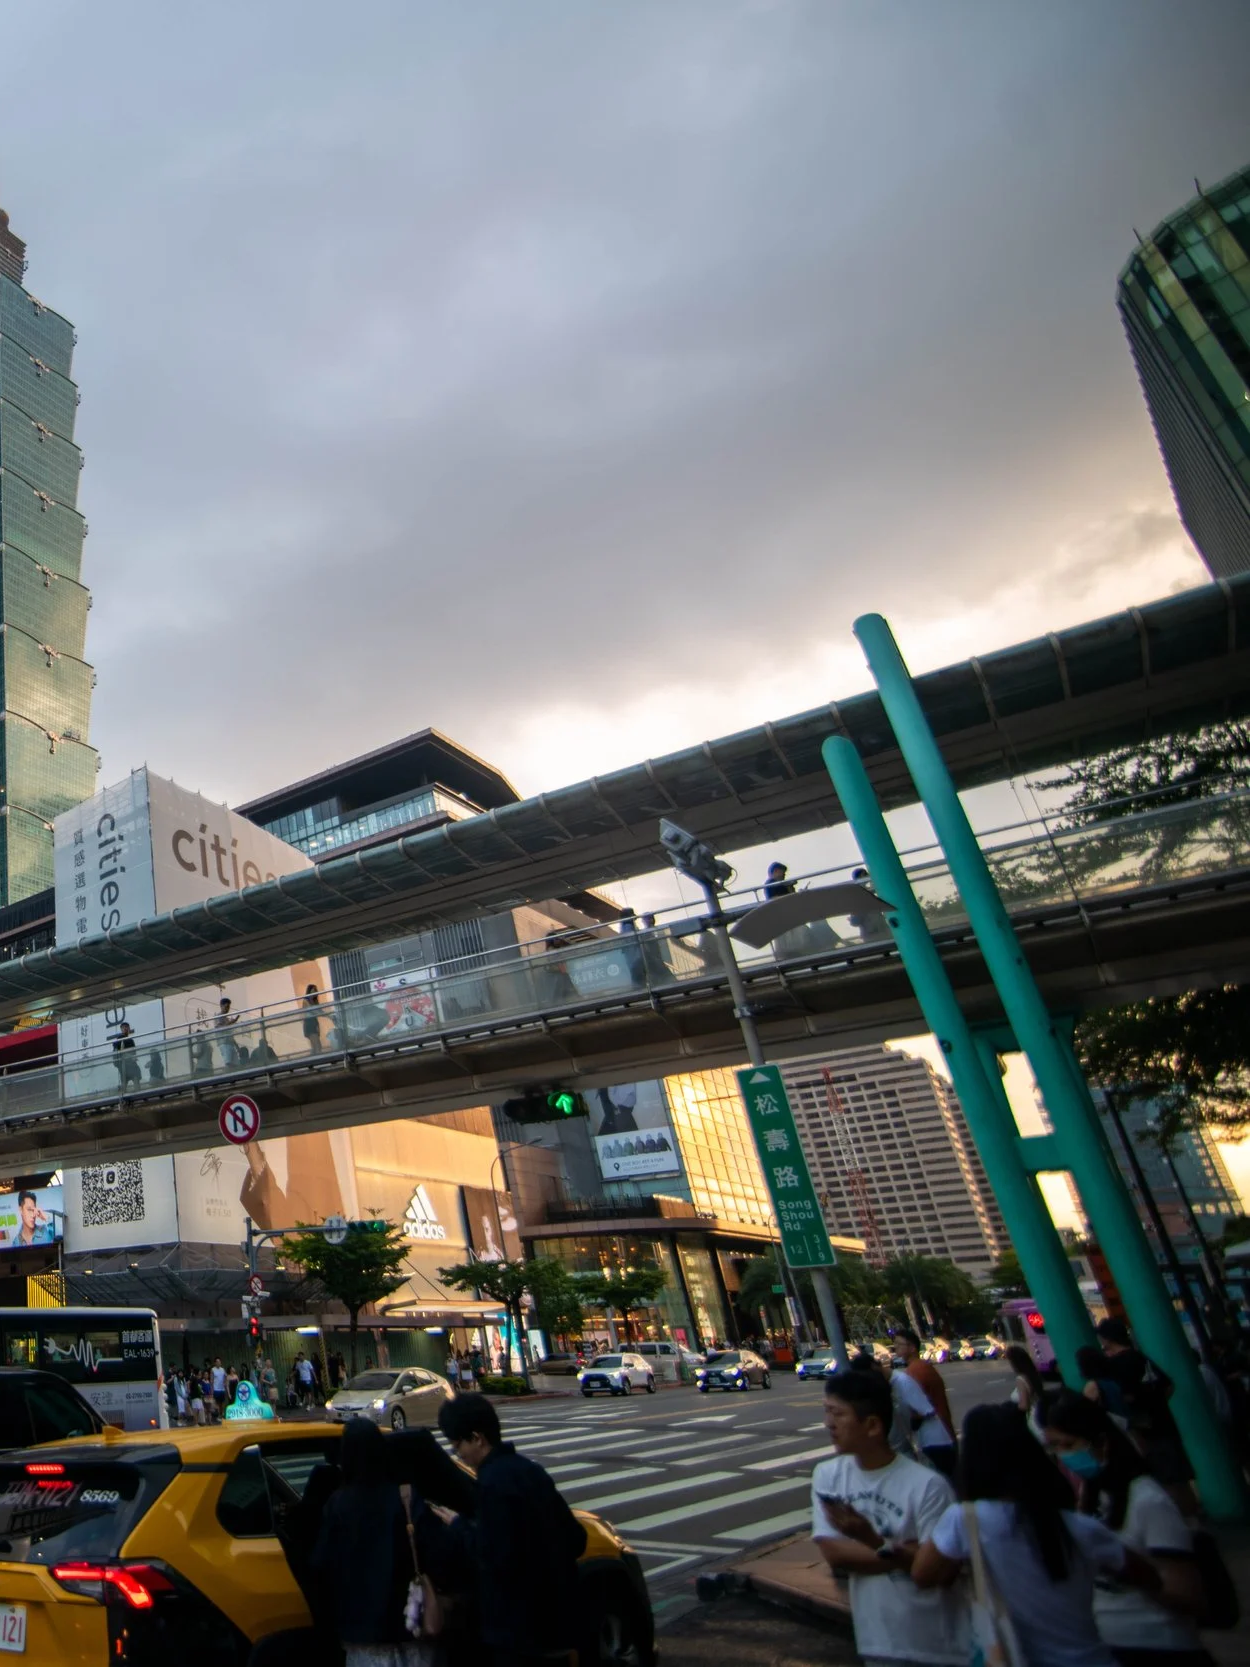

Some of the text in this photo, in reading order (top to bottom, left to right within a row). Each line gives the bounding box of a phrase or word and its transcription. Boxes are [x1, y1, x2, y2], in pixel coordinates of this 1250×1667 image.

[172, 823, 277, 890] citie
[97, 813, 126, 932] cities
[753, 1093, 800, 1190] 松壽路
[778, 1200, 812, 1210] Song
[781, 1211, 815, 1221] Shou
[403, 1219, 446, 1240] adidas
[783, 1221, 804, 1231] Rd.
[790, 1245, 803, 1255] 12
[123, 1348, 155, 1359] EAL-1639
[79, 1489, 120, 1503] 8569
